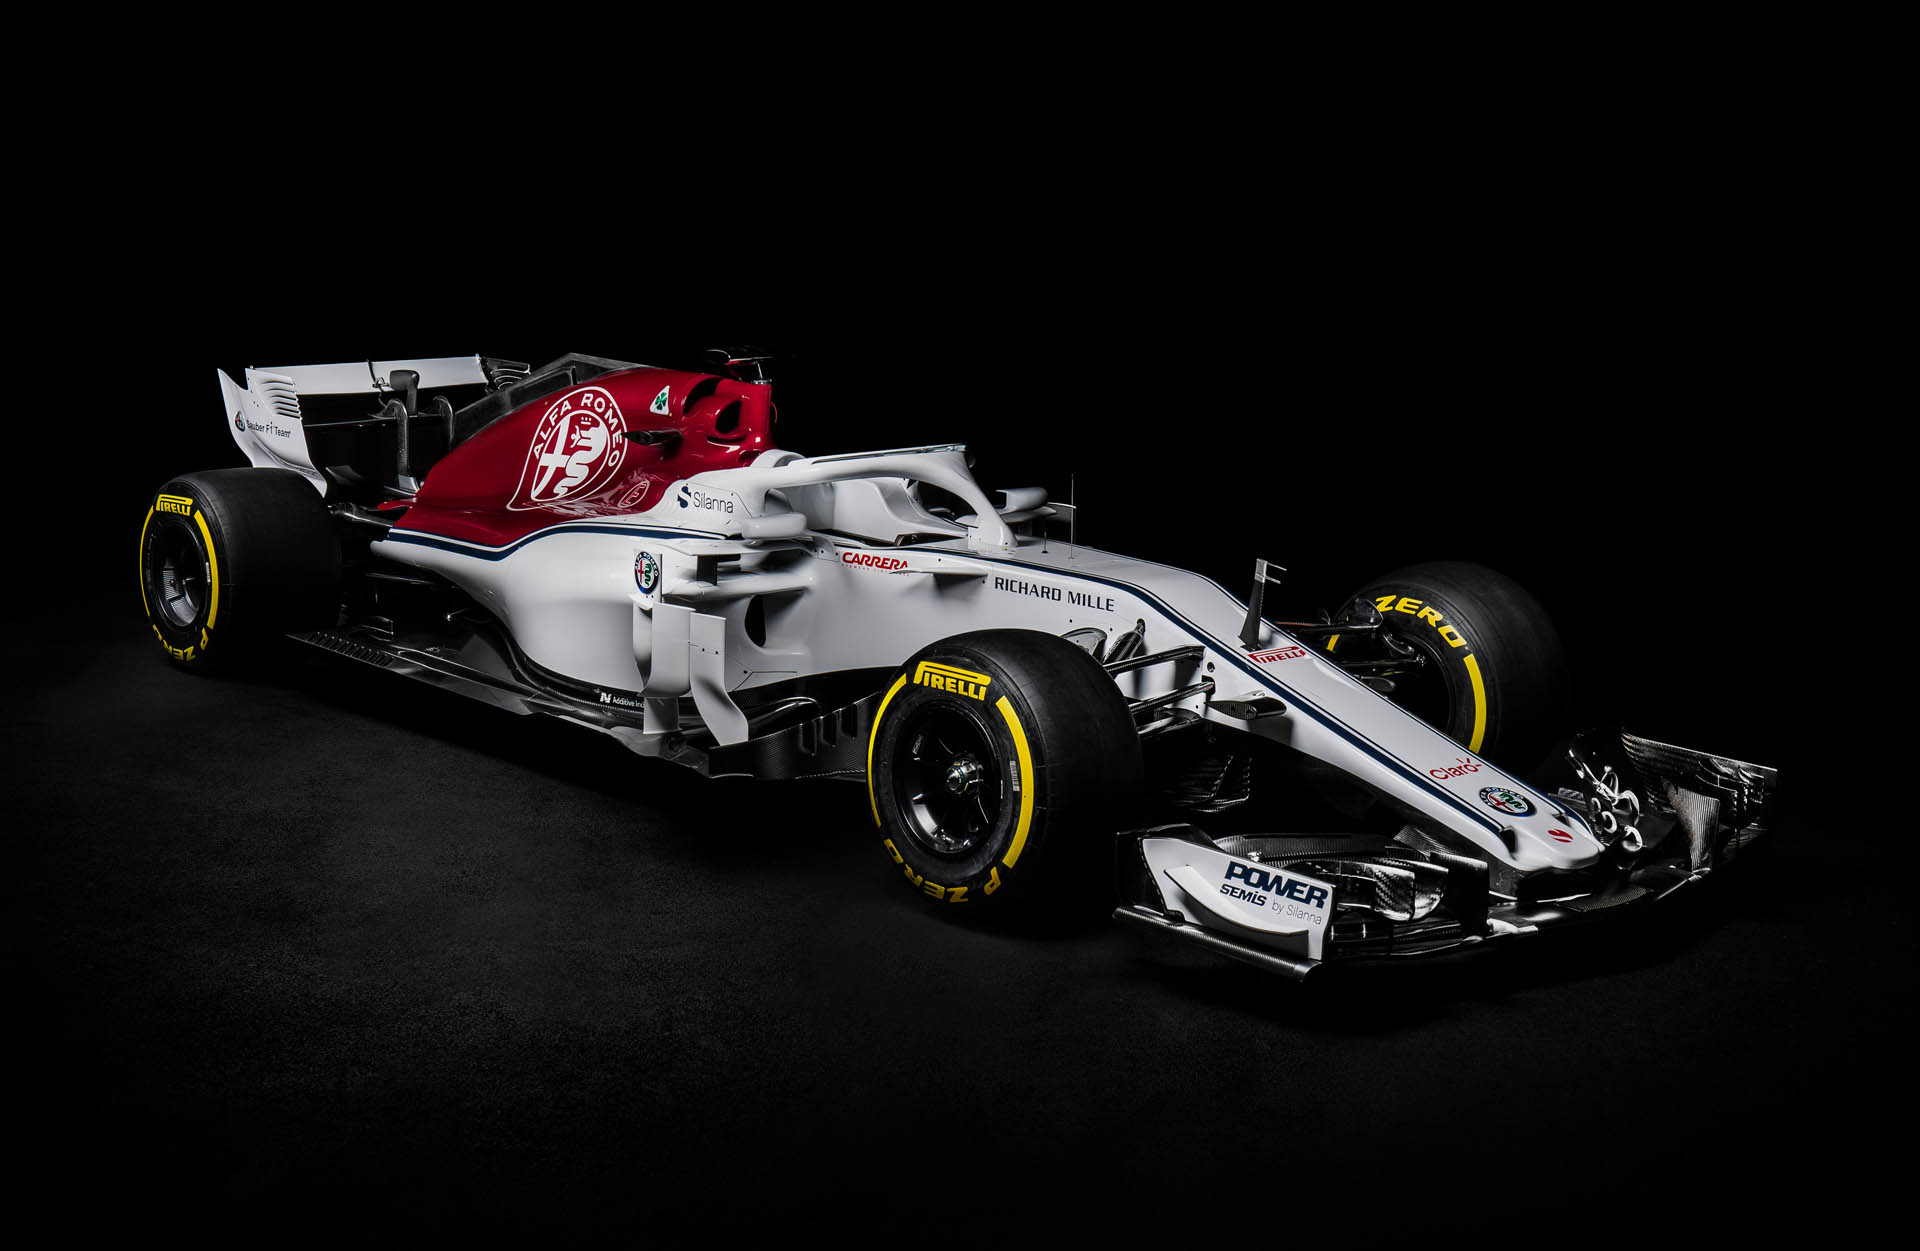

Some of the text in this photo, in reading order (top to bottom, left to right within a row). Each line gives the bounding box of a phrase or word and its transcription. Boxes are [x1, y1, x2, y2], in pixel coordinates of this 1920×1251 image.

[533, 393, 623, 468] ALFA ROMEO
[155, 494, 193, 517] PIRELLI
[693, 491, 734, 514] Silanna
[842, 551, 908, 571] CARRERA
[994, 576, 1115, 612] RICHARD MILLE
[1376, 595, 1467, 648] ZERO
[1247, 646, 1306, 664] PIRELLI
[913, 660, 992, 701] PIRELLI
[1429, 757, 1483, 780] Claro
[883, 837, 1002, 903] P ZERO
[1224, 860, 1329, 909] POWER
[1271, 897, 1285, 915] by
[1286, 904, 1322, 926] Silanna
